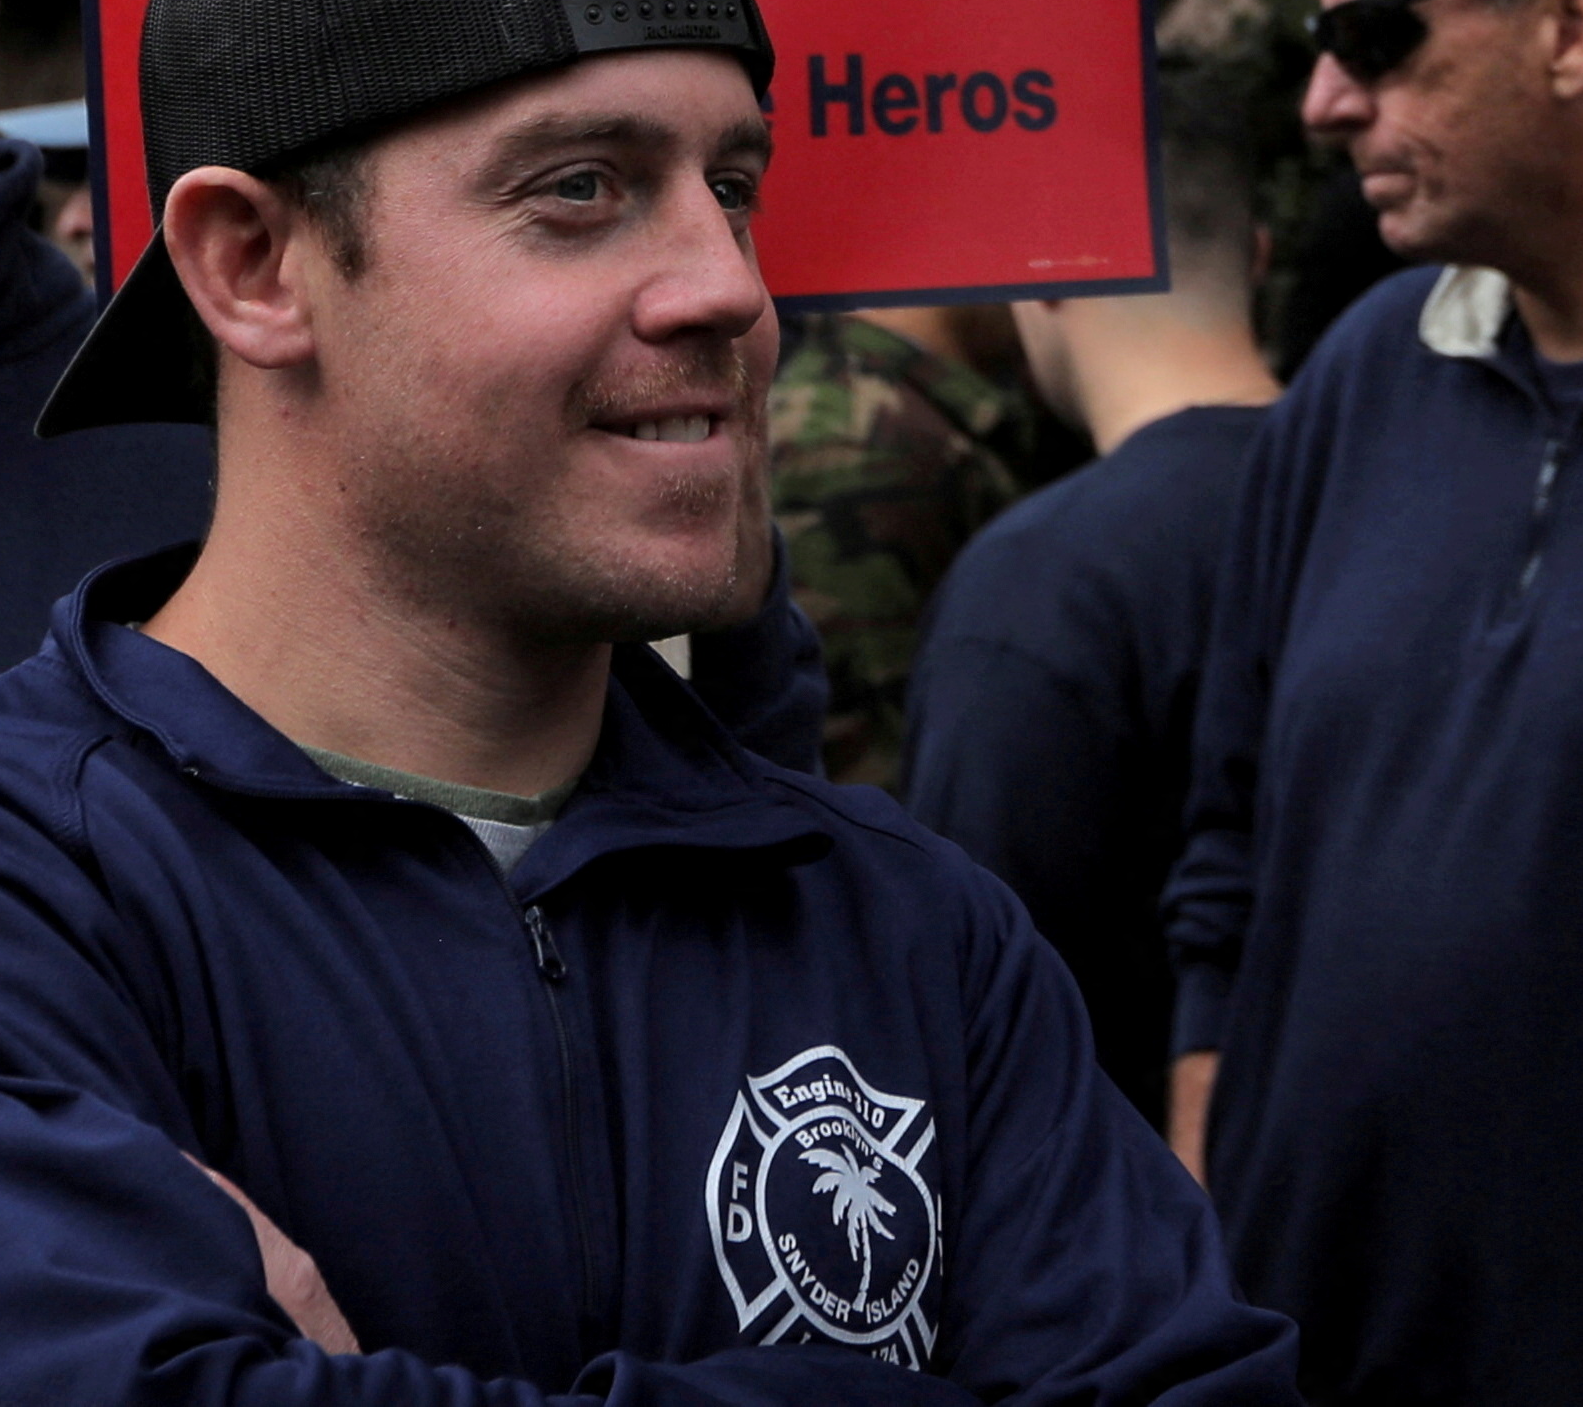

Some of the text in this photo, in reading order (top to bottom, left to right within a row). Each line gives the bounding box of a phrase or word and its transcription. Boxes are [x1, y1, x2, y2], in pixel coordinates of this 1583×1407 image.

[807, 52, 1058, 139] Heros
[773, 1073, 852, 1109] Engine
[778, 1232, 851, 1322] SNYDER
[866, 1257, 920, 1324] ISLAND
